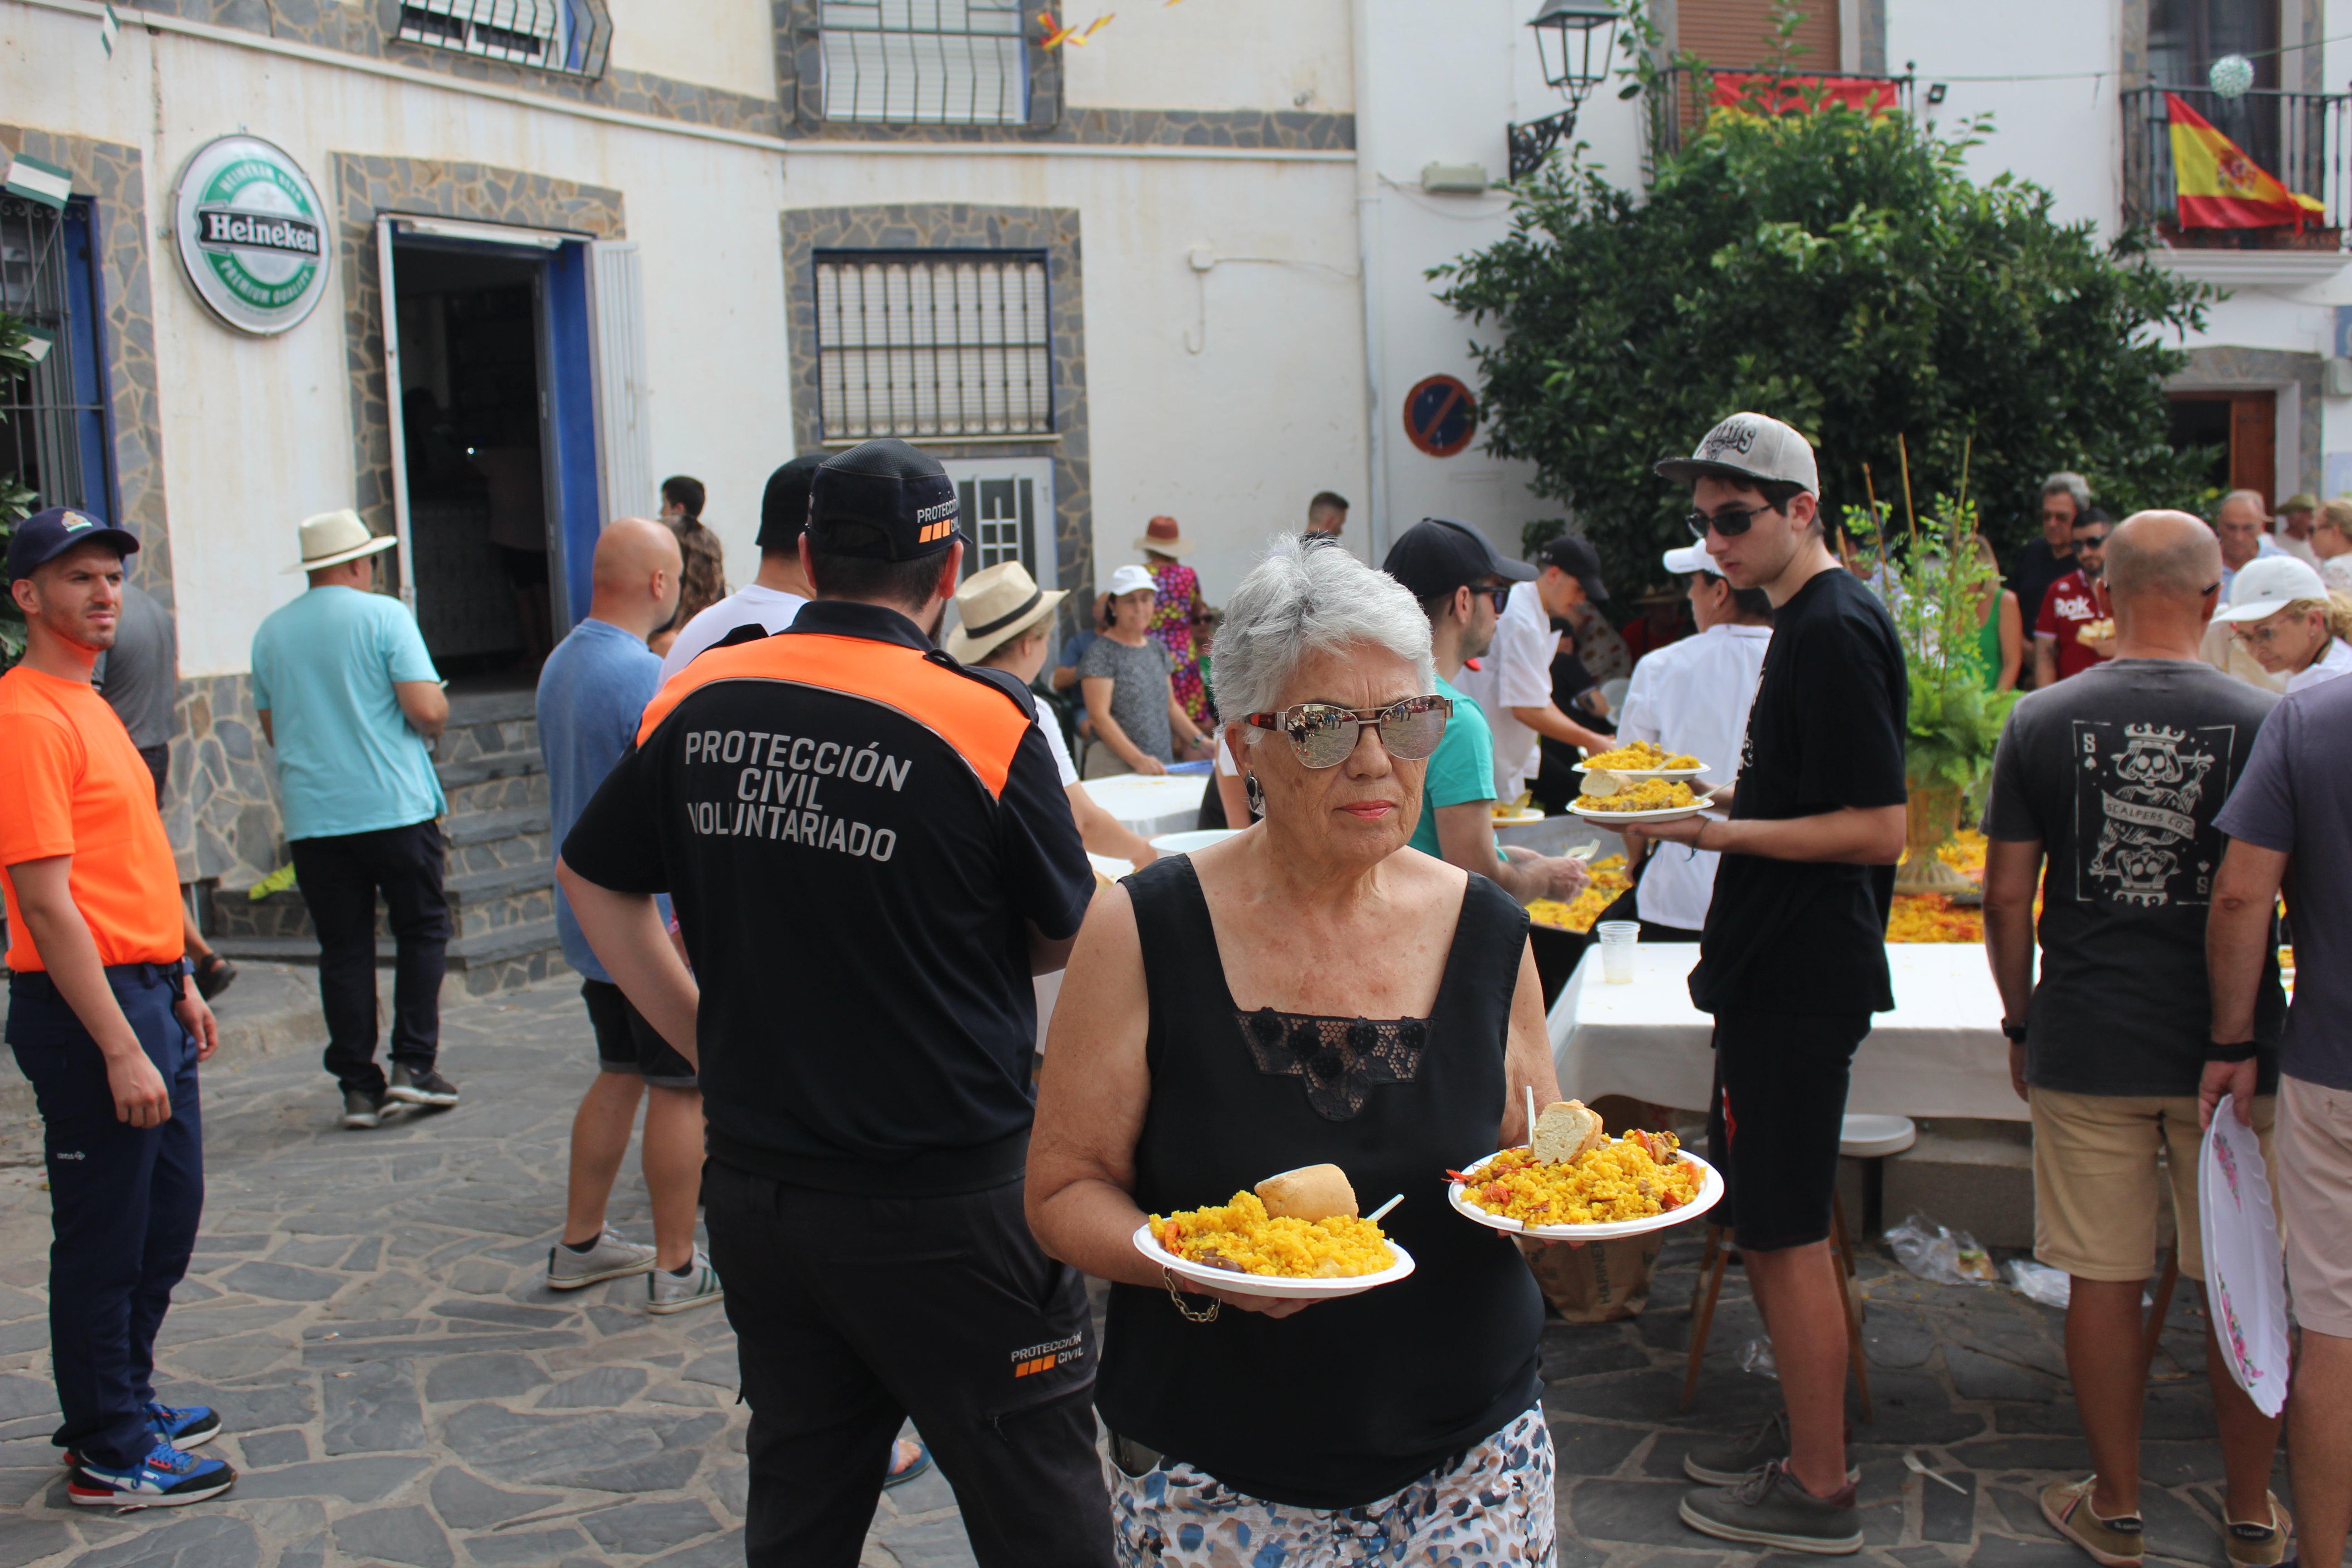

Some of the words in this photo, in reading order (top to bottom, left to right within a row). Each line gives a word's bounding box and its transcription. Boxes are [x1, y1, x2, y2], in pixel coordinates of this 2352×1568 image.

[208, 213, 318, 253] Heineken
[685, 730, 912, 792] PROTECCIÓN
[737, 768, 823, 811] CIVIL
[687, 802, 897, 862] VOLUNTARIADO
[2105, 803, 2164, 822] SCALPERS
[1011, 1331, 1082, 1362] PROTECCIÓN
[1058, 1347, 1083, 1364] CIVIL
